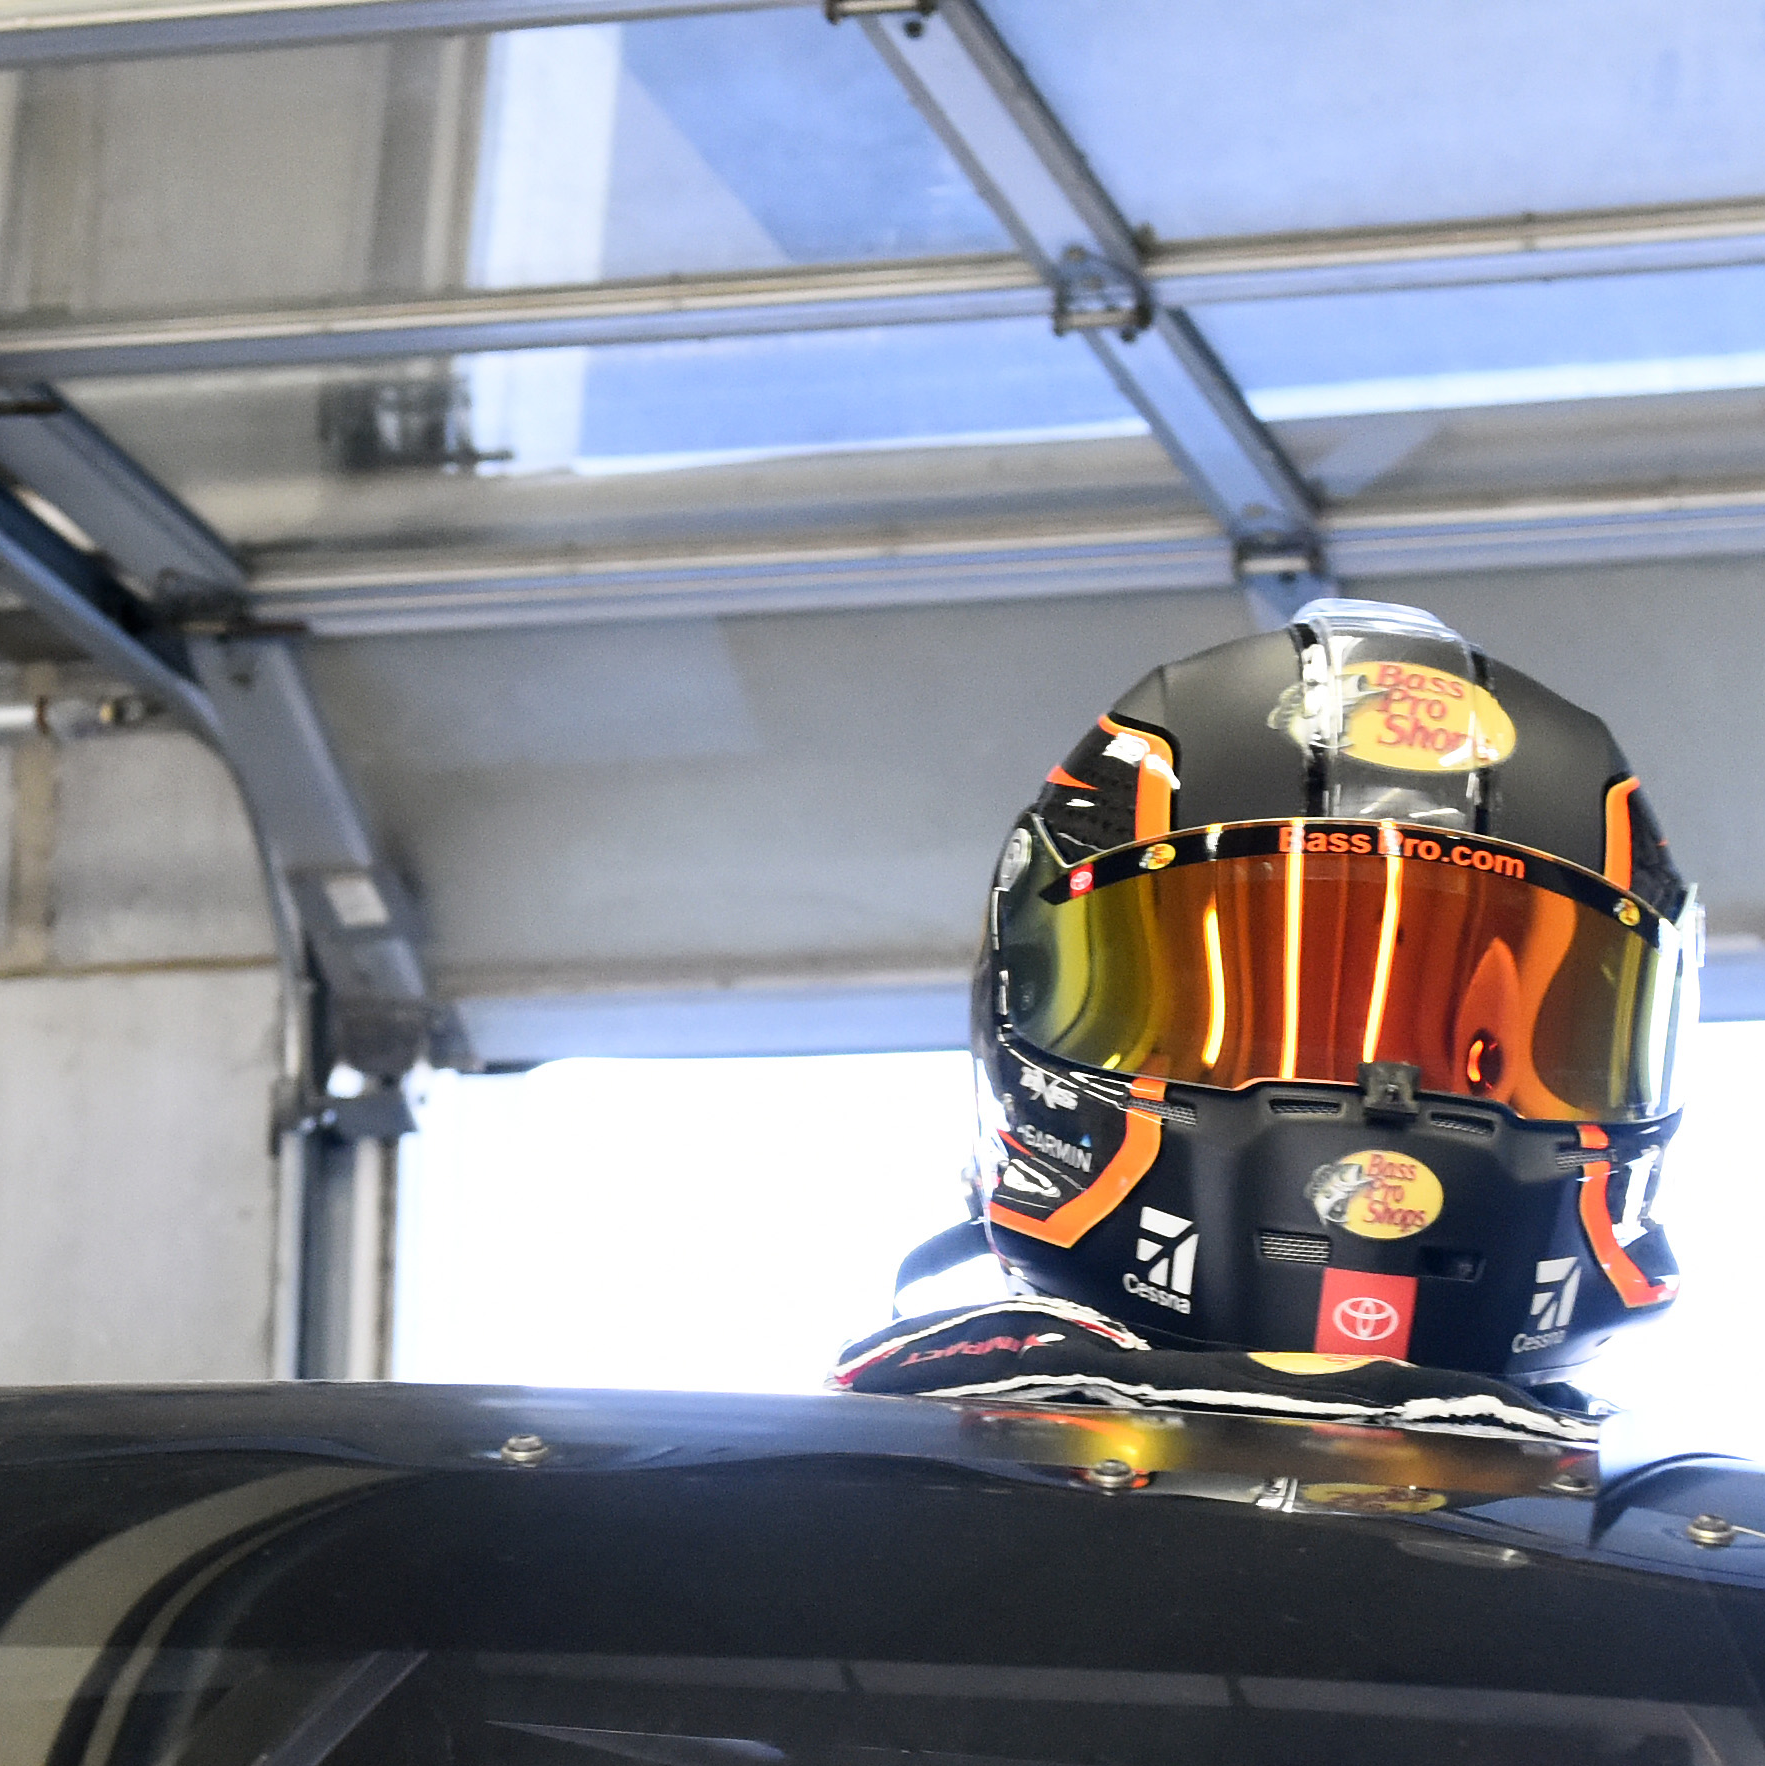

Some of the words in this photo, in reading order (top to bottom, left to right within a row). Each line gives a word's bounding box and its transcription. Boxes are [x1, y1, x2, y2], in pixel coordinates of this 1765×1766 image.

[1375, 663, 1465, 699] Bass
[1378, 688, 1448, 720] Pro
[1017, 1124, 1093, 1173] GARMIN
[1365, 1153, 1418, 1181] Bass
[1363, 1178, 1406, 1204] Pro
[1363, 1199, 1427, 1233] Shops
[1122, 1273, 1192, 1315] Cessna
